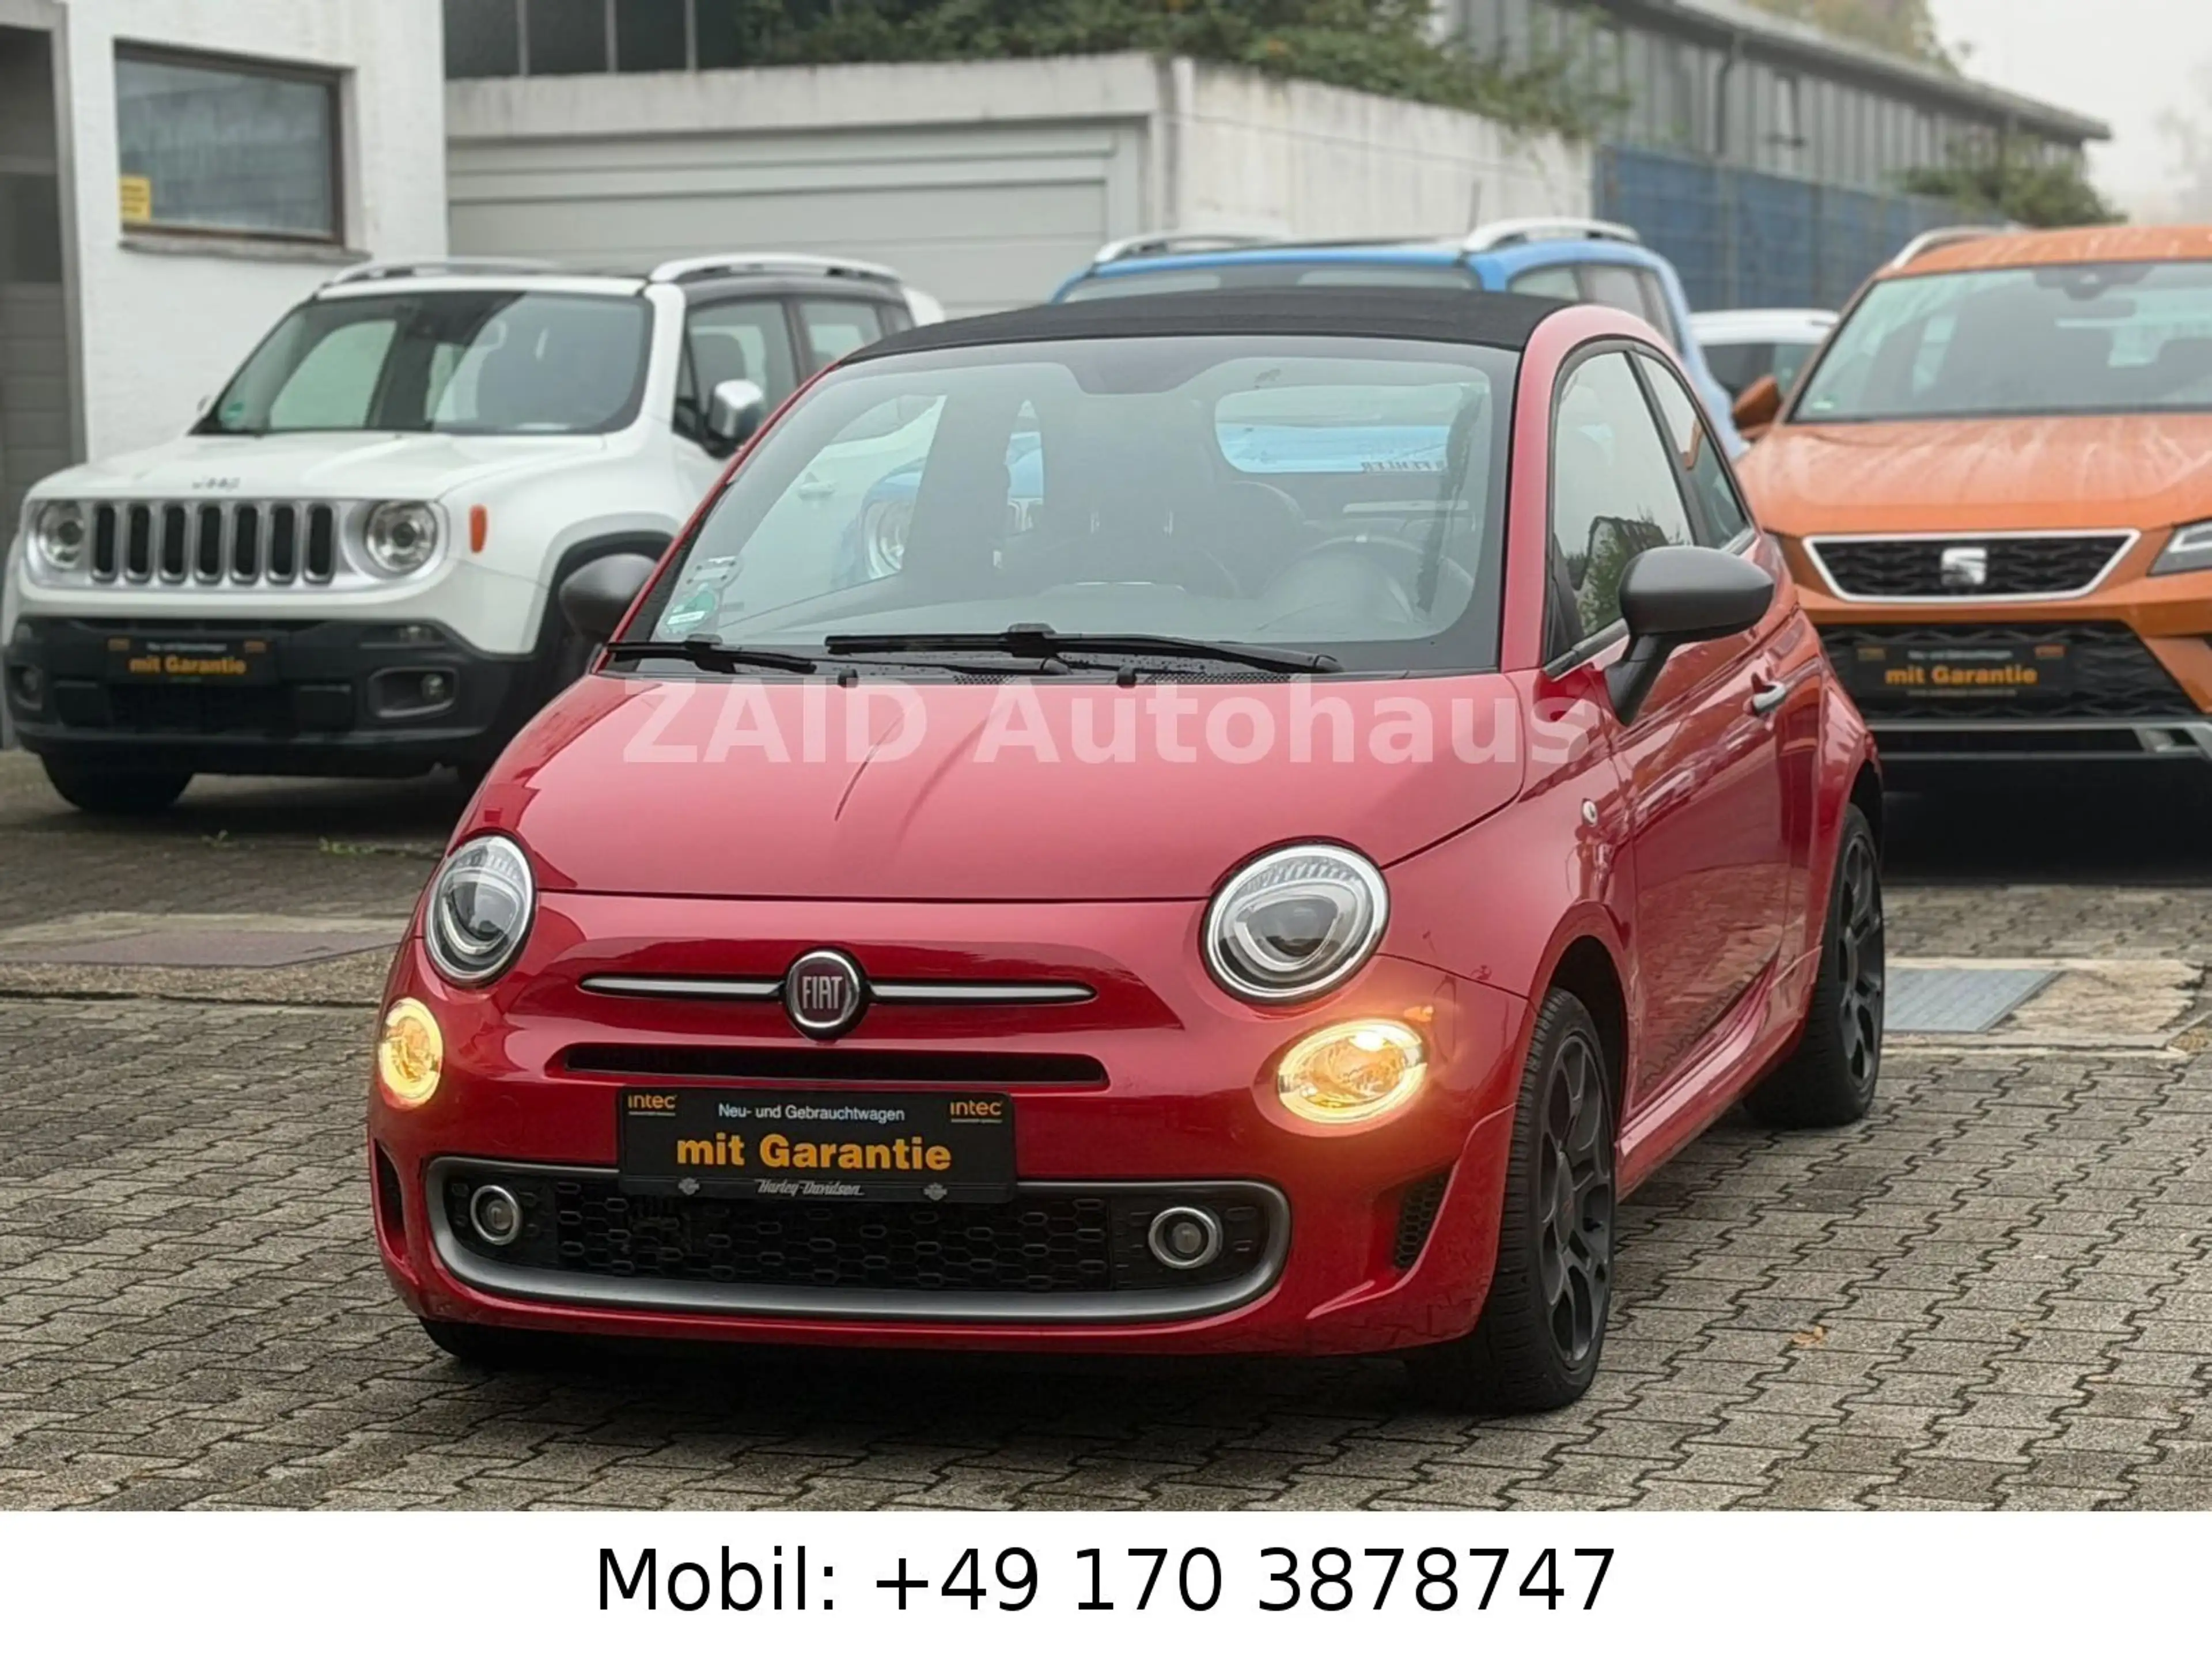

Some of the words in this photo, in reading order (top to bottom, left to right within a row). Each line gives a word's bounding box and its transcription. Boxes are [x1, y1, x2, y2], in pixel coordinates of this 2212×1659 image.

[130, 656, 161, 674] mit
[165, 654, 247, 675] Garantie
[1885, 666, 1926, 685] mit
[1931, 664, 2039, 685] Garantie
[802, 976, 843, 1010] FIAT
[628, 1093, 676, 1109] intec
[950, 1100, 1002, 1116] intec
[718, 1103, 751, 1118] Neu-
[755, 1105, 781, 1118] und
[785, 1104, 905, 1124] Gebrauchtwagen
[677, 1132, 745, 1166] mit
[759, 1133, 952, 1171] Garantie
[754, 1179, 865, 1196] Harley-Davidson
